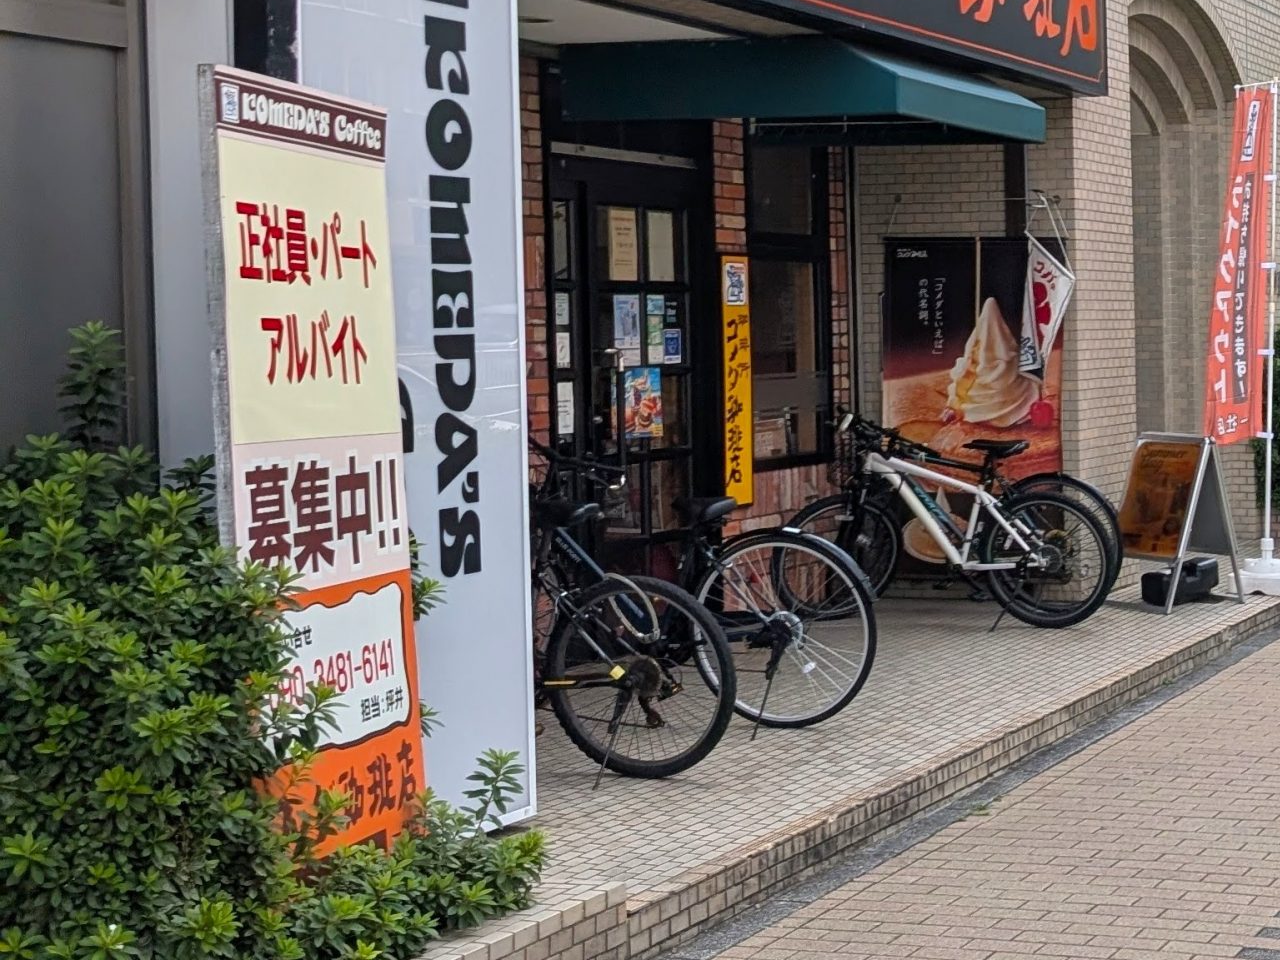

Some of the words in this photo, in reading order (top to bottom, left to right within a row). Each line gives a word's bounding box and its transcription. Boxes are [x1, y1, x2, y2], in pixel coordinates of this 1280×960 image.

[241, 92, 330, 139] KOMEDA'S
[334, 114, 382, 150] Coffee
[235, 201, 377, 289] 正社員・パート
[424, 14, 482, 578] KOMEDA'S
[260, 309, 368, 385] アルバイト
[725, 318, 744, 487] コメダ珈琲店
